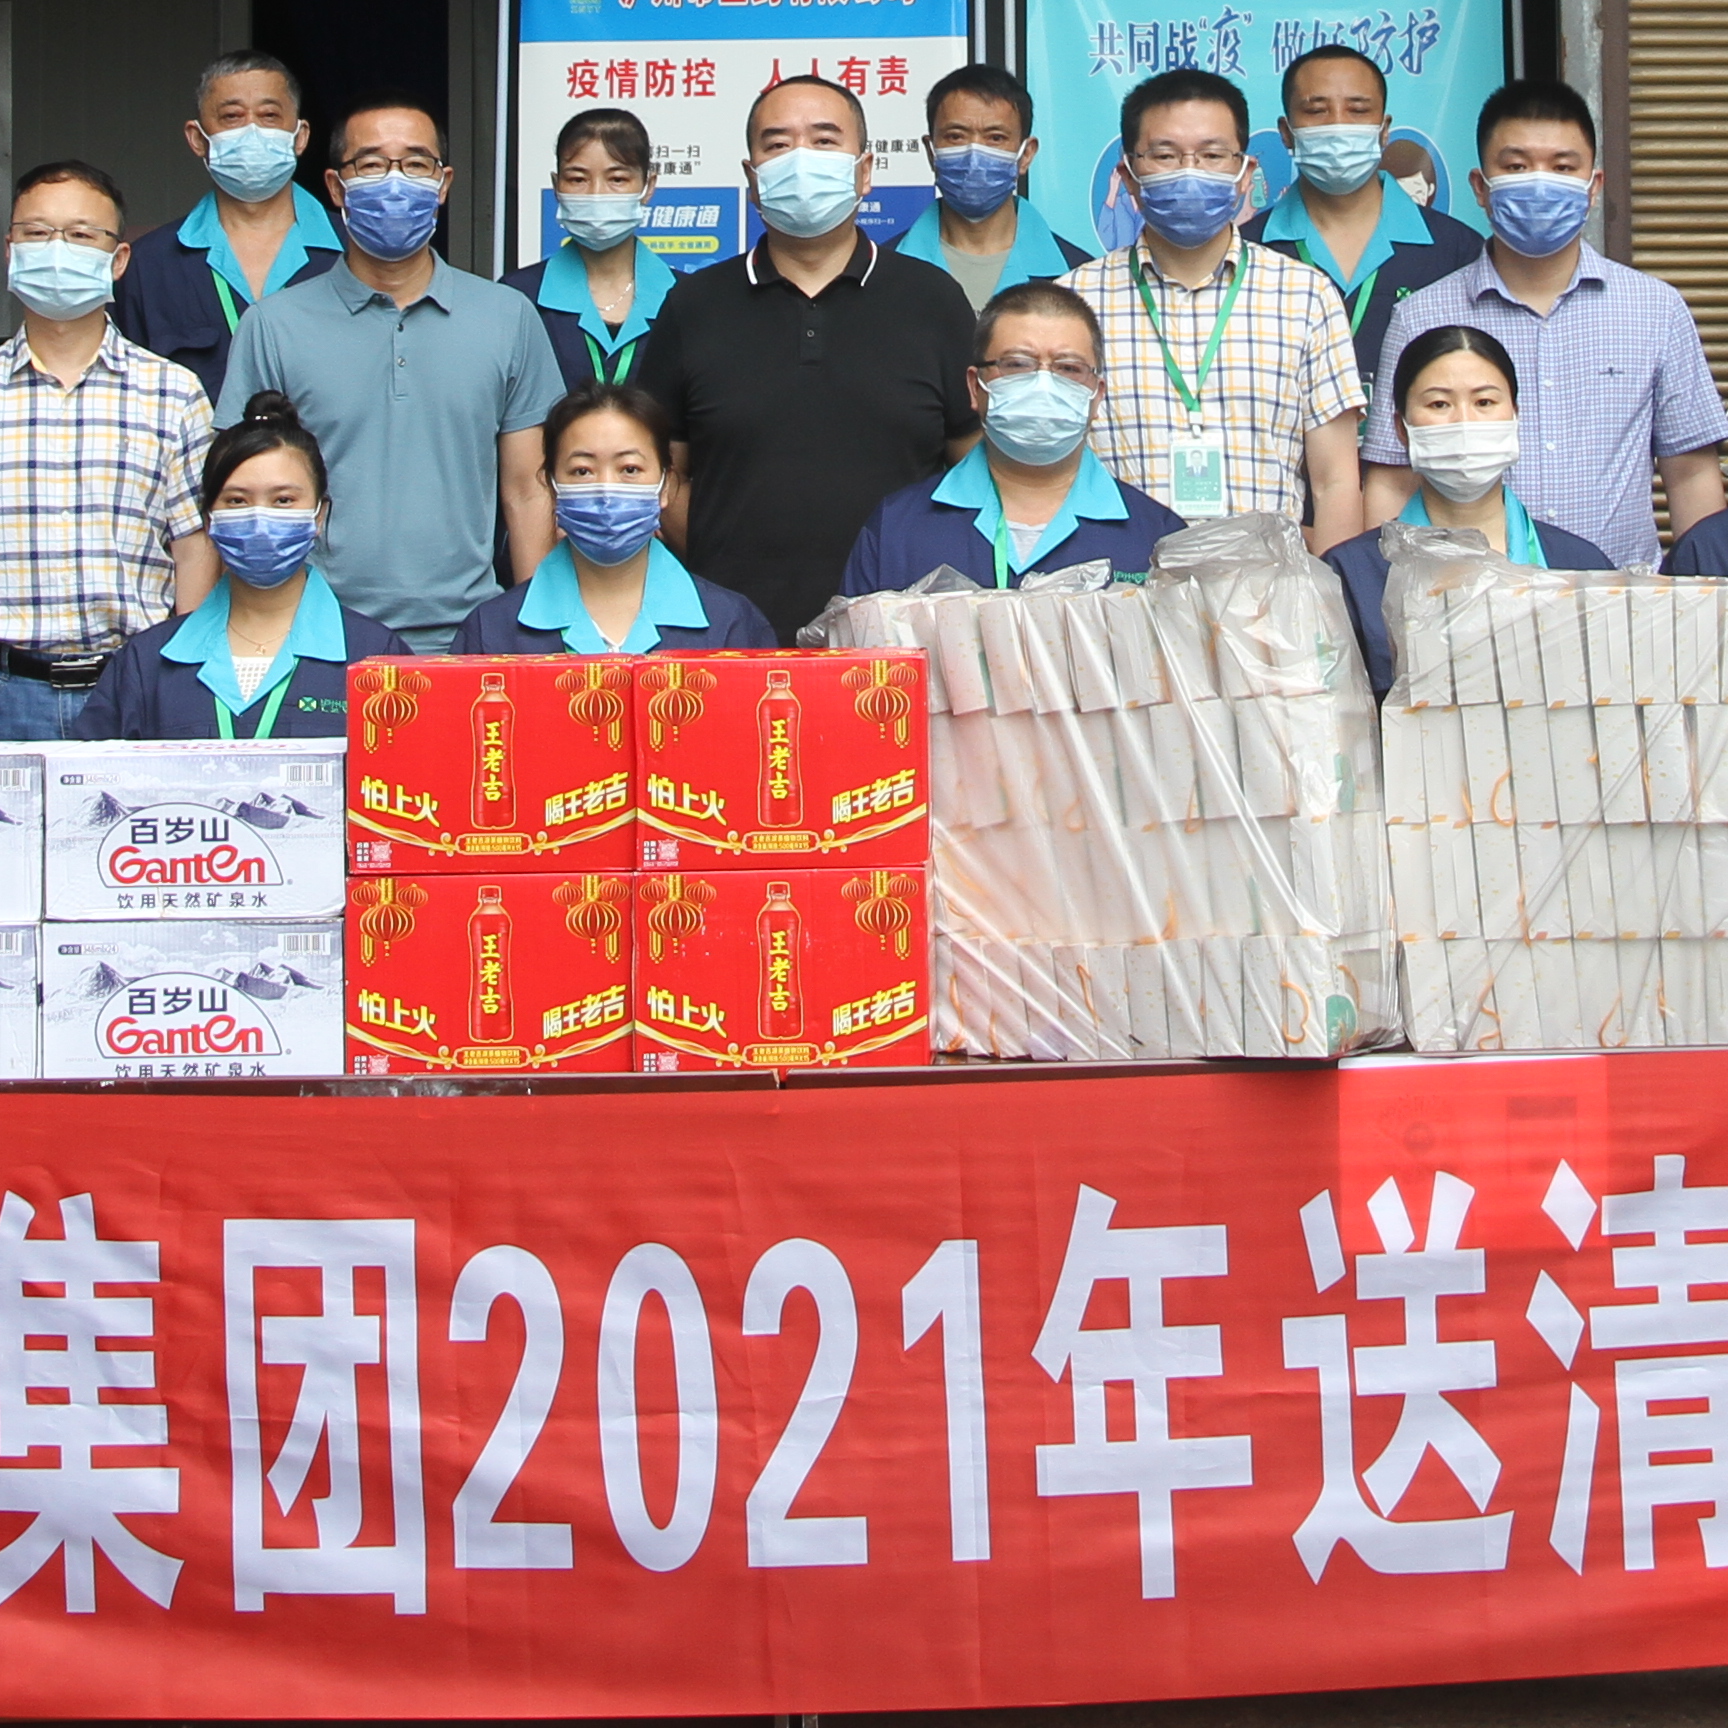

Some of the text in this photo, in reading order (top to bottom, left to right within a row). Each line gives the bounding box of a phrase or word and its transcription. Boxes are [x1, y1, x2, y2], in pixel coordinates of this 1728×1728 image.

[566, 57, 717, 99] 疫情防控
[648, 144, 701, 159] 扫一扫
[482, 721, 504, 801] 王老吉
[768, 719, 791, 800] 王老吉
[360, 775, 440, 827] 怕上火
[545, 771, 629, 827] 喝王老吉
[647, 773, 727, 826] 怕上火
[832, 768, 916, 825] 喝王老吉
[130, 816, 229, 844] 百岁山
[117, 892, 268, 909] 饮用天然矿泉水
[479, 934, 502, 1014] 王老吉
[768, 930, 791, 1012] 王老吉
[128, 986, 228, 1015] 百岁山
[358, 988, 438, 1041] 怕上火
[542, 984, 626, 1040] 喝王老吉
[647, 985, 727, 1038] 怕上火
[832, 980, 916, 1037] 喝王老吉
[115, 1062, 266, 1077] 饮用天然矿泉水
